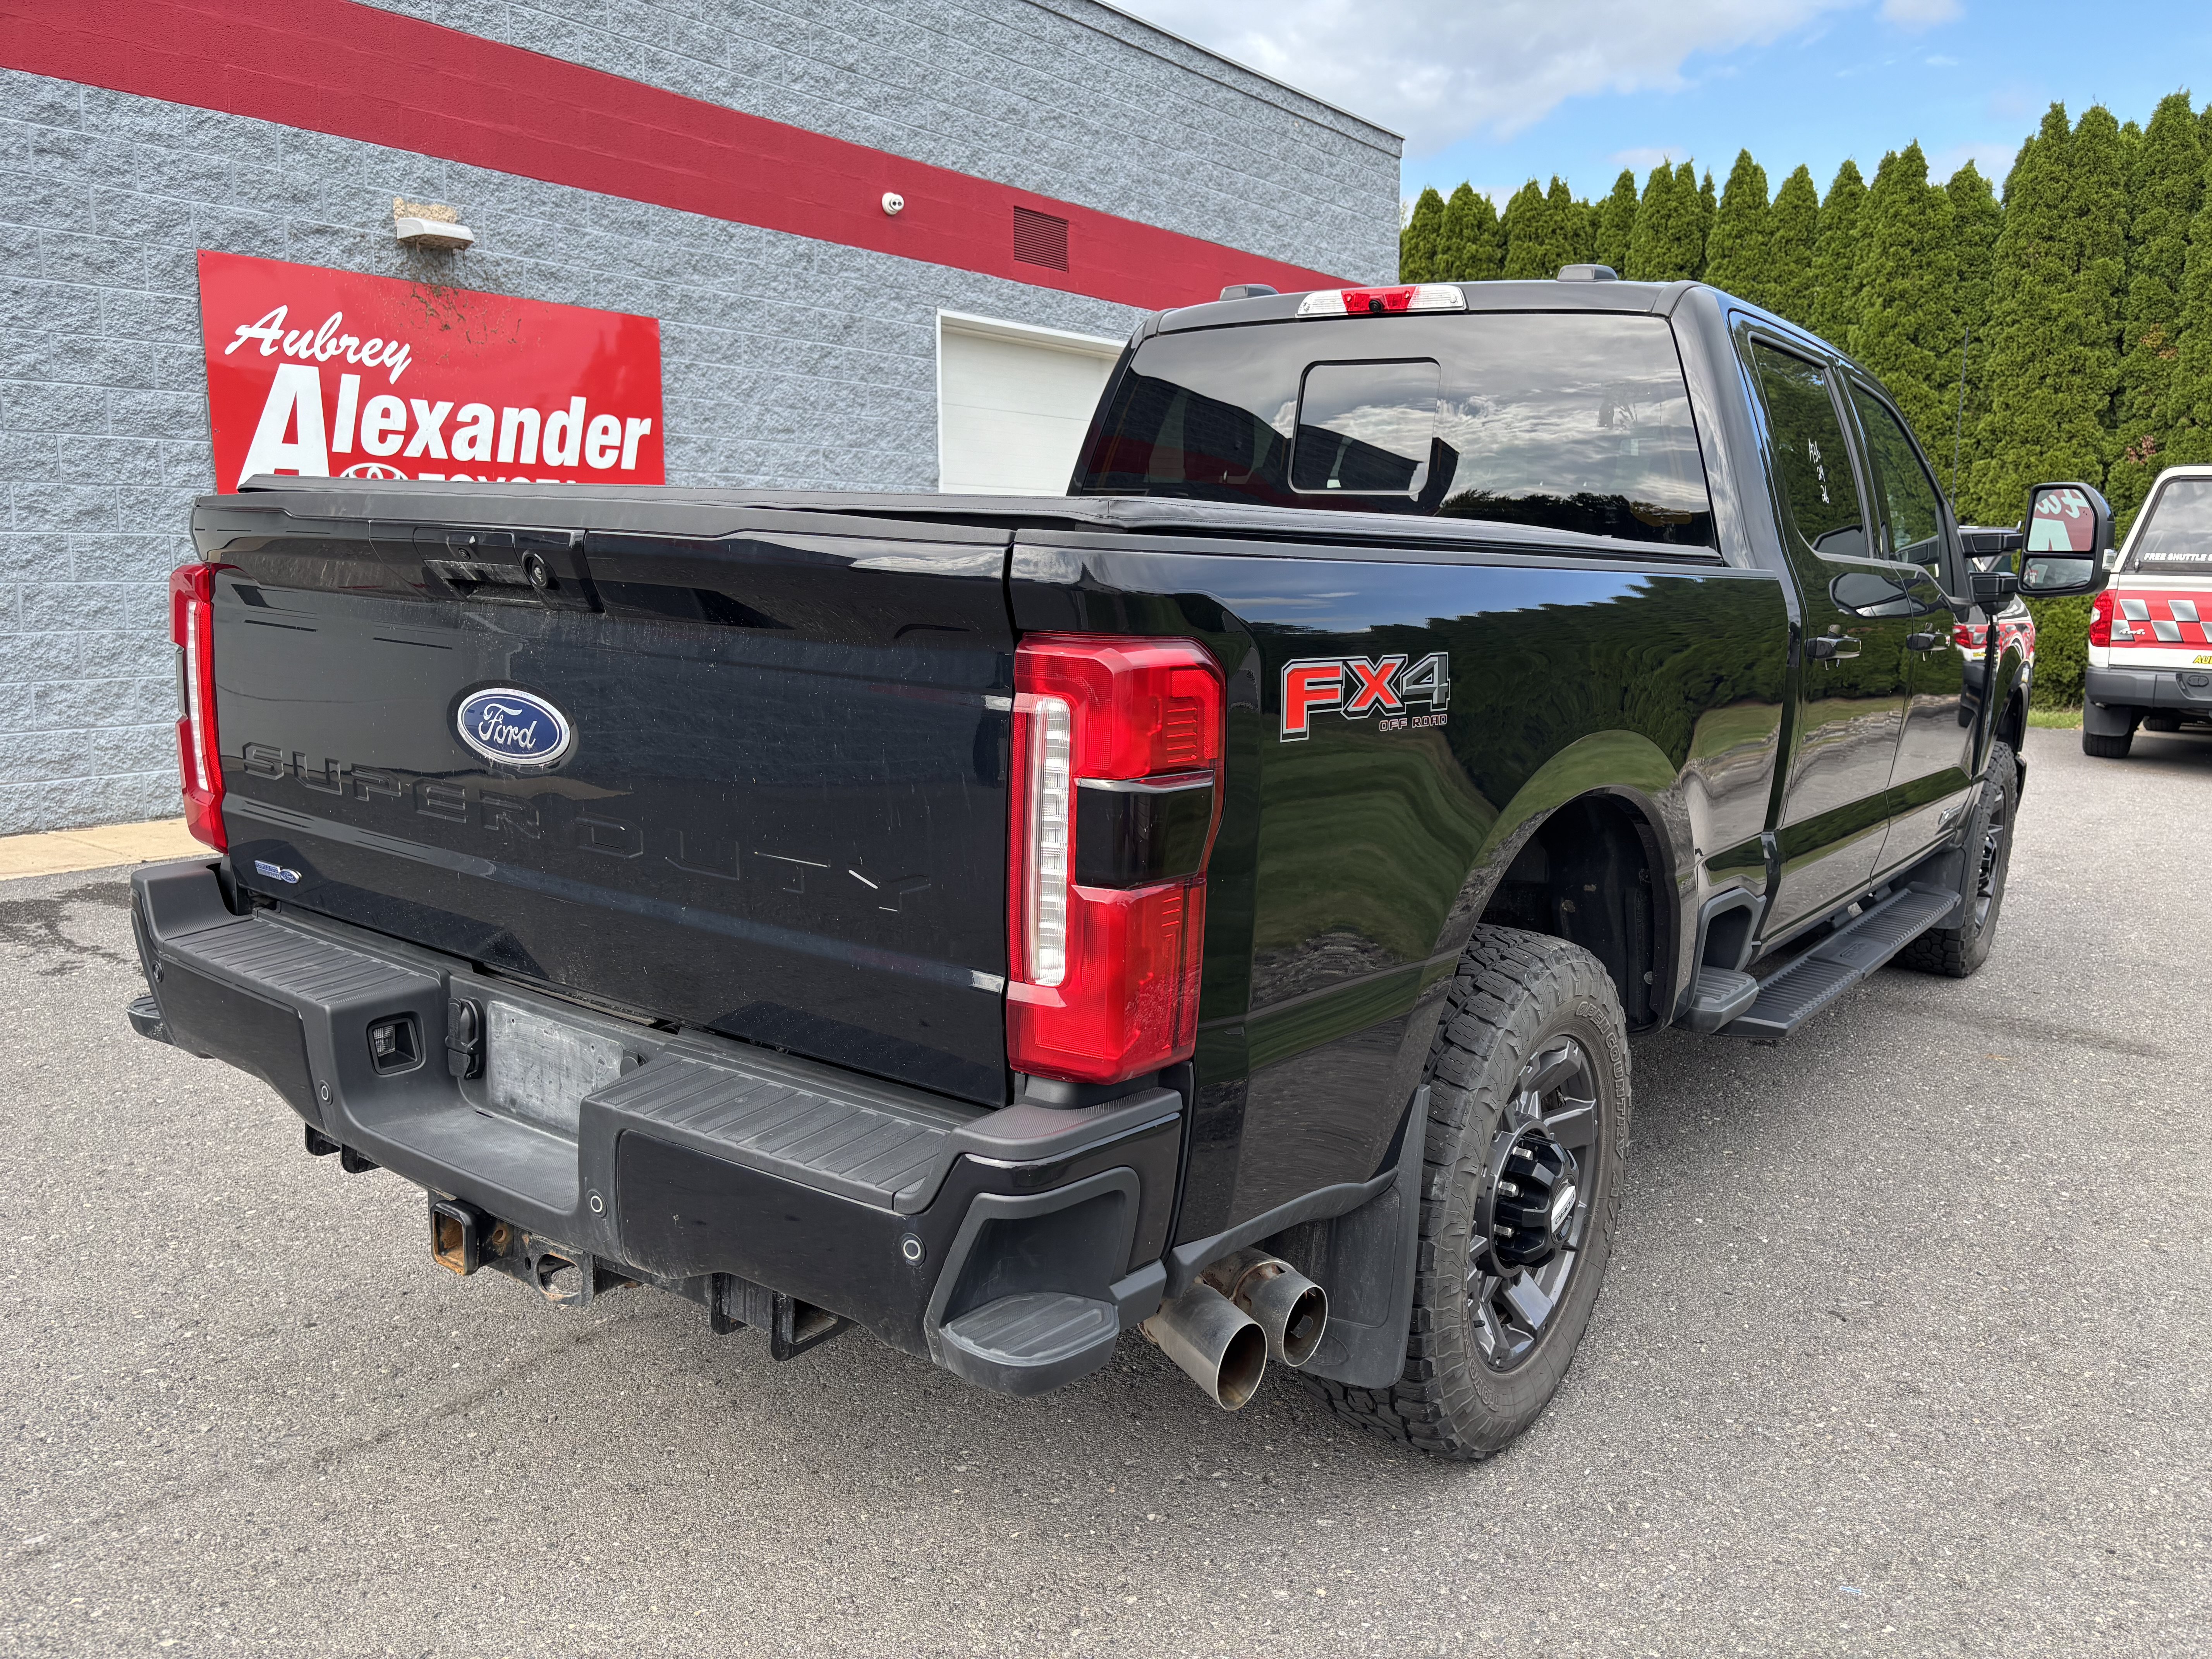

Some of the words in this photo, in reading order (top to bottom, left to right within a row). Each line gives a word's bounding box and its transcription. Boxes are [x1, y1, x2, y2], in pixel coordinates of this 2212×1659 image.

[225, 304, 412, 385] Aubrey
[237, 363, 652, 485] Alexander
[2167, 553, 2207, 561] SHUTTLE
[478, 703, 538, 749] Ford
[1280, 651, 1450, 743] FX4
[1379, 718, 1408, 732] OFF
[1412, 714, 1448, 728] ROAD
[242, 742, 540, 840] SUPER
[575, 809, 931, 912] DUTY
[1576, 1001, 1611, 1034] OPEN
[1606, 1032, 1626, 1159] COUNTRY
[1555, 1194, 1574, 1225] FORD
